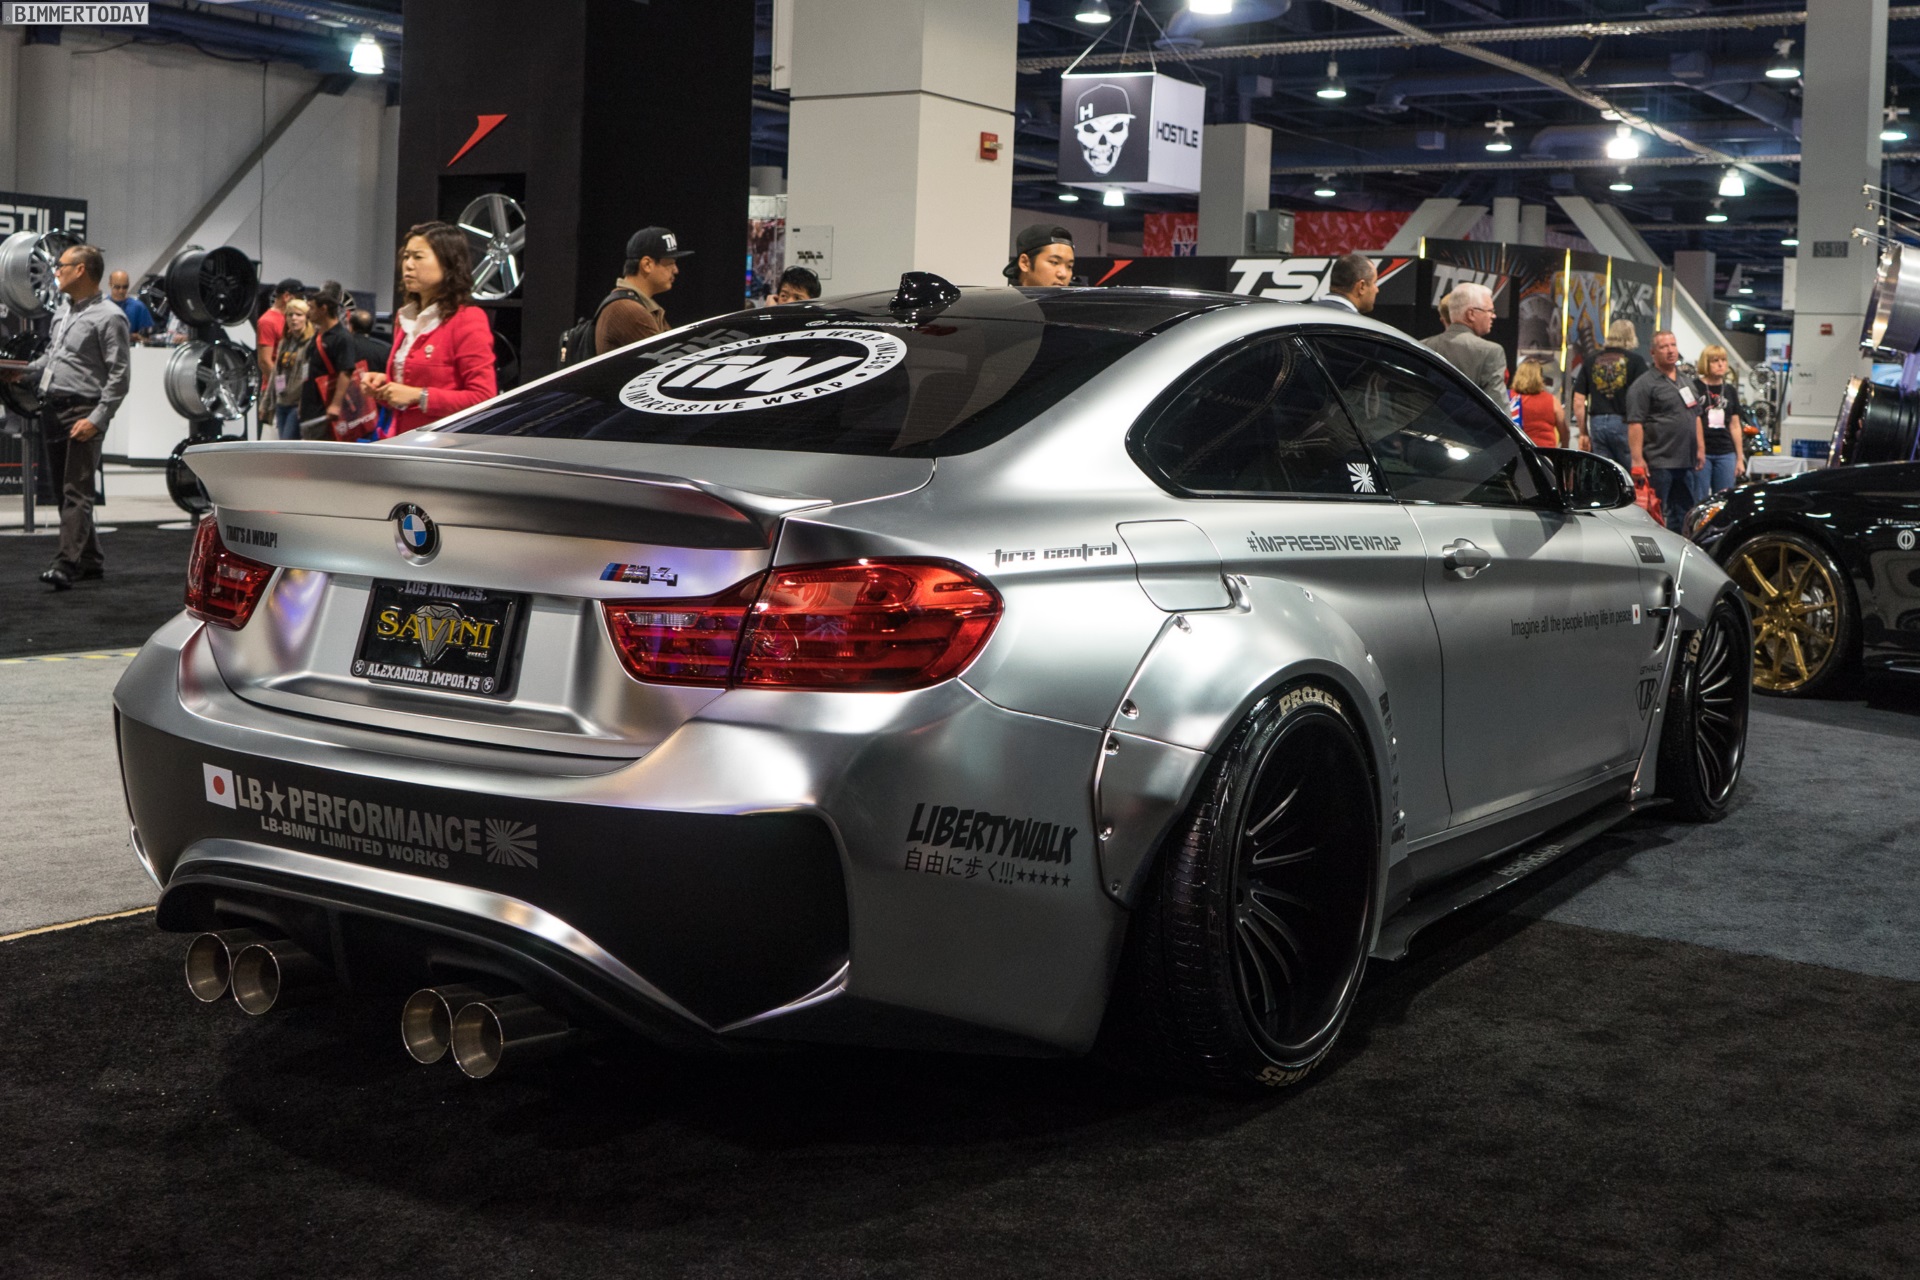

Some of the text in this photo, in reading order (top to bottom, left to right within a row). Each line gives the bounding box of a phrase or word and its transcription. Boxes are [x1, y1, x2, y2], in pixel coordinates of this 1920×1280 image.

[1155, 120, 1199, 149] HOSTILE
[1229, 257, 1384, 301] TS
[681, 353, 705, 362] IT
[719, 333, 790, 351] AIN'T
[826, 330, 885, 342] WRAP
[862, 341, 899, 369] UNLESS
[625, 389, 747, 413] IMPRESSIVE
[762, 381, 844, 405] WRAP
[252, 529, 278, 549] WRAP!
[1043, 541, 1118, 562] central
[404, 581, 428, 596] LOS
[377, 609, 495, 649] SAVINI
[1510, 618, 1540, 640] Imagine
[1541, 615, 1550, 633] all
[1550, 614, 1561, 632] the
[1562, 612, 1583, 635] people
[1583, 611, 1599, 631] living
[366, 662, 481, 691] ALEXANDER IMPORTS
[1278, 686, 1342, 717] PROXES
[287, 786, 483, 856] PERFORMANCE
[261, 815, 450, 869] LB-BMW LIMITED WORKS
